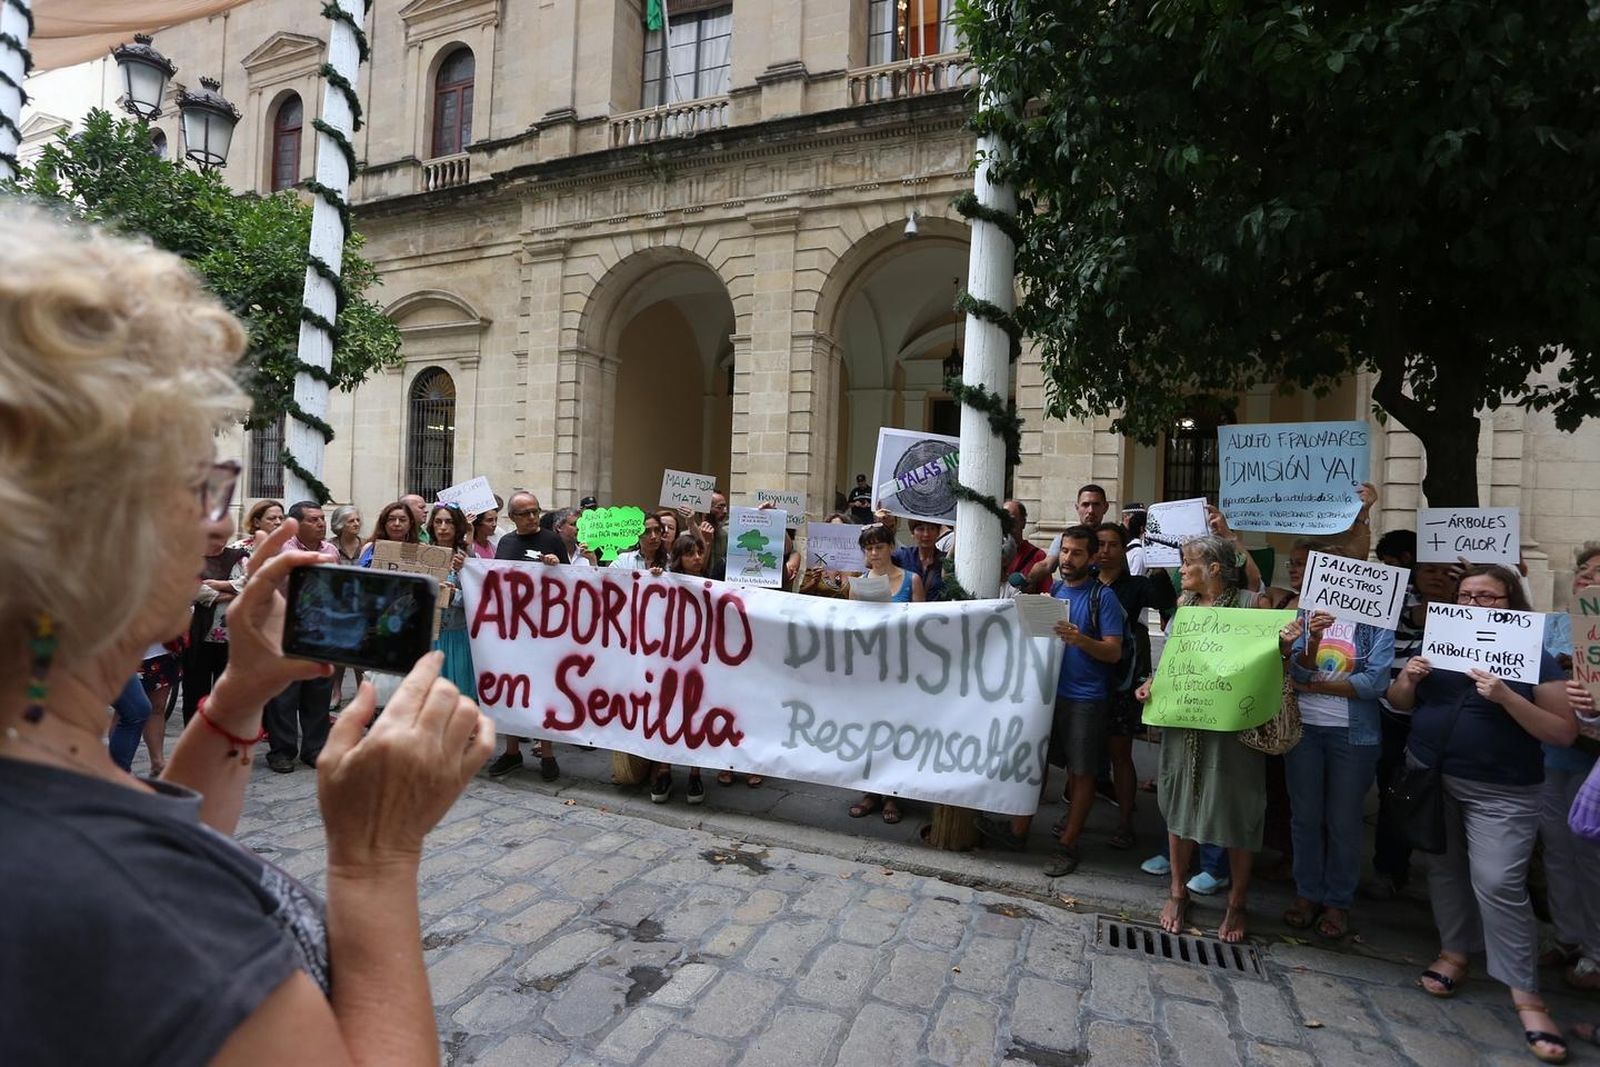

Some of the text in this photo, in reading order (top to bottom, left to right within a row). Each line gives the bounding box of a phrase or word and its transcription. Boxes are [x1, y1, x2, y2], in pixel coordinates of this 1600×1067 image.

[1227, 433, 1270, 450] ADOLFO
[666, 473, 691, 488] MALA
[1321, 456, 1359, 487] YA!
[672, 492, 702, 505] MATA
[1447, 513, 1506, 529] ÁRBOLES
[1320, 573, 1383, 595] NUESTROS
[1429, 605, 1531, 628] MALAS PODAS
[1427, 641, 1481, 662] ÁRBOLES
[1489, 665, 1521, 679] MOS
[478, 654, 745, 749] en Sevilla
[781, 700, 1049, 787] Responsables
